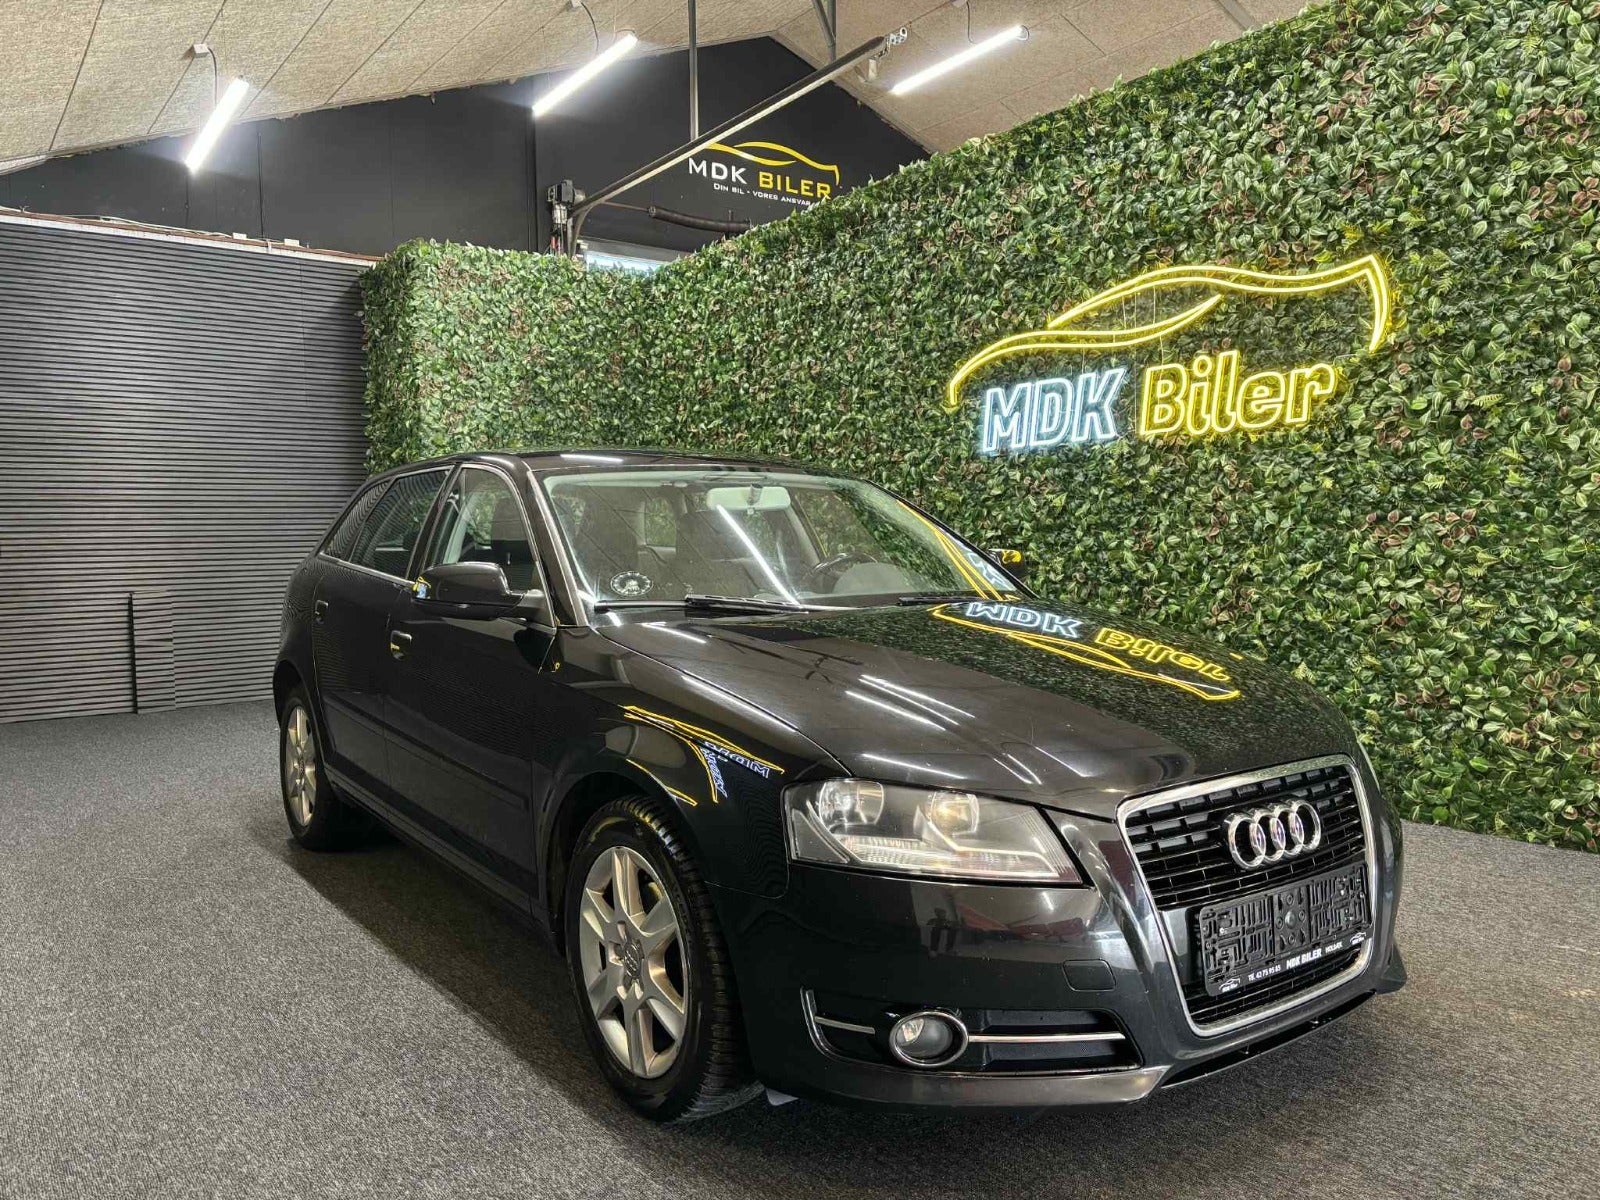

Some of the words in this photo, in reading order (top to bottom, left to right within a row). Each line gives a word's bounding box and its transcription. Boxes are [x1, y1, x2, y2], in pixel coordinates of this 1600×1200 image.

[688, 157, 748, 185] MDK
[759, 171, 832, 200] BILER
[713, 183, 729, 192] DIN
[731, 186, 745, 194] BIL
[752, 190, 779, 201] VORES
[982, 366, 1127, 454] MDK
[1140, 349, 1338, 436] Biler
[1286, 956, 1301, 970] MDK
[1301, 948, 1322, 963] BILER
